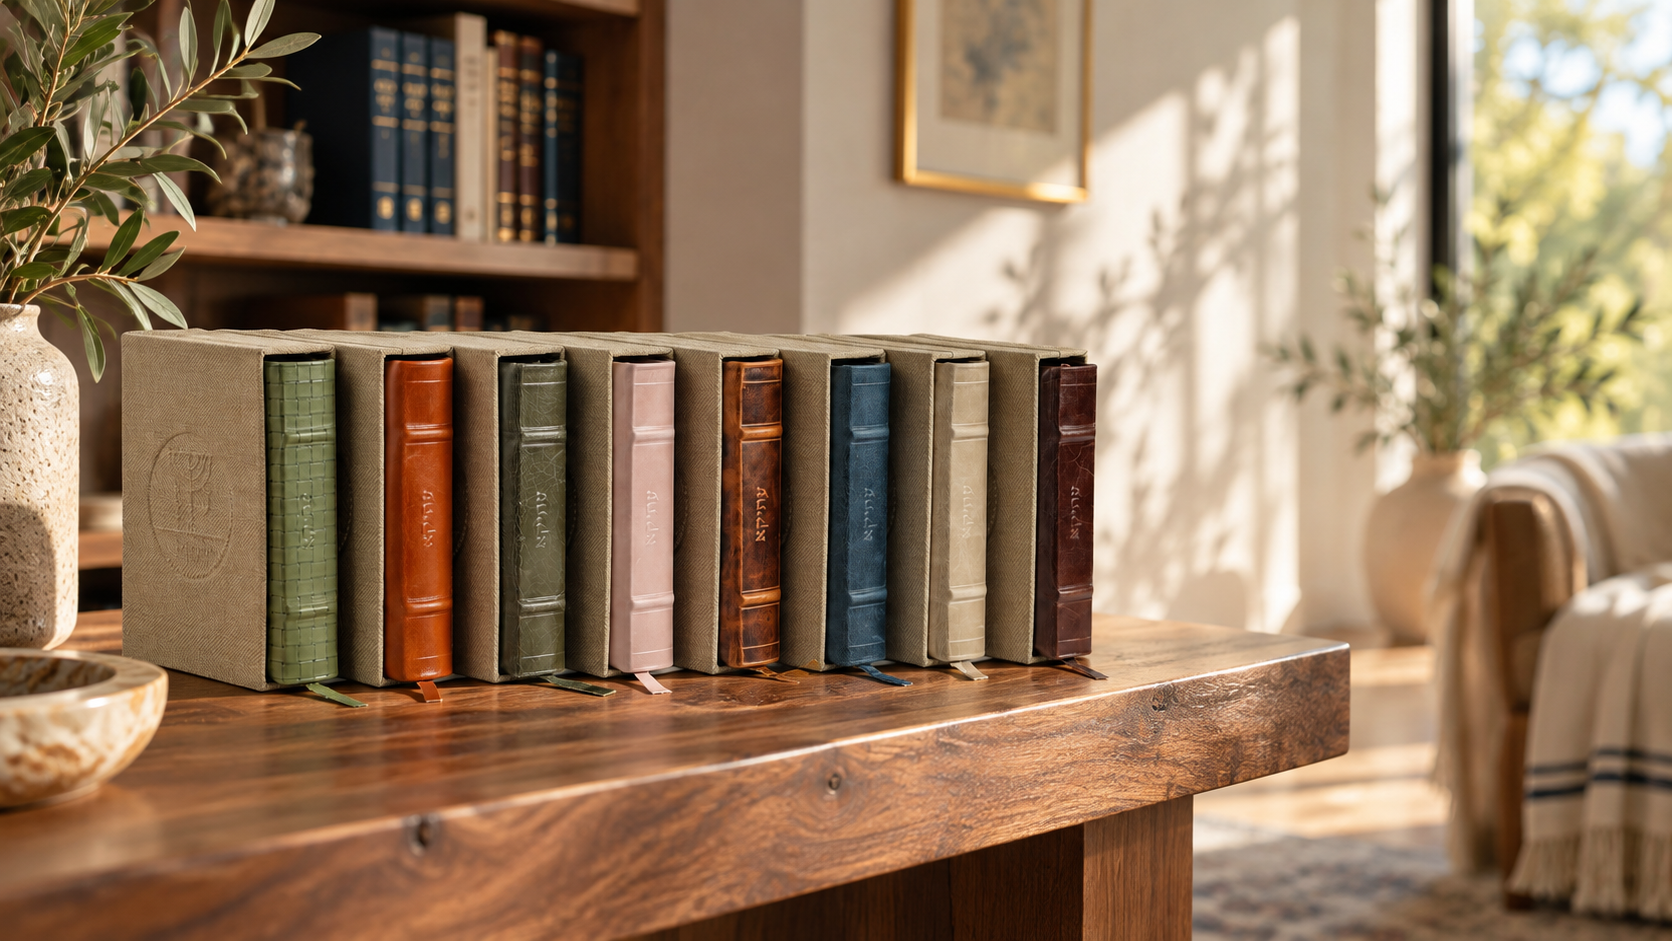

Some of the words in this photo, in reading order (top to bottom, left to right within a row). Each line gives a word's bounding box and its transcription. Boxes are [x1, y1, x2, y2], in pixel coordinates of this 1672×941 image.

[300, 492, 316, 549] עתיקא
[421, 490, 437, 548] עתיקא
[535, 491, 550, 549] עתיקא
[645, 490, 660, 546] עתיקא
[754, 486, 769, 542] עתיקא
[863, 487, 878, 541] עתיקא
[961, 485, 975, 539] עתיקא
[1069, 485, 1083, 540] עתיקא
